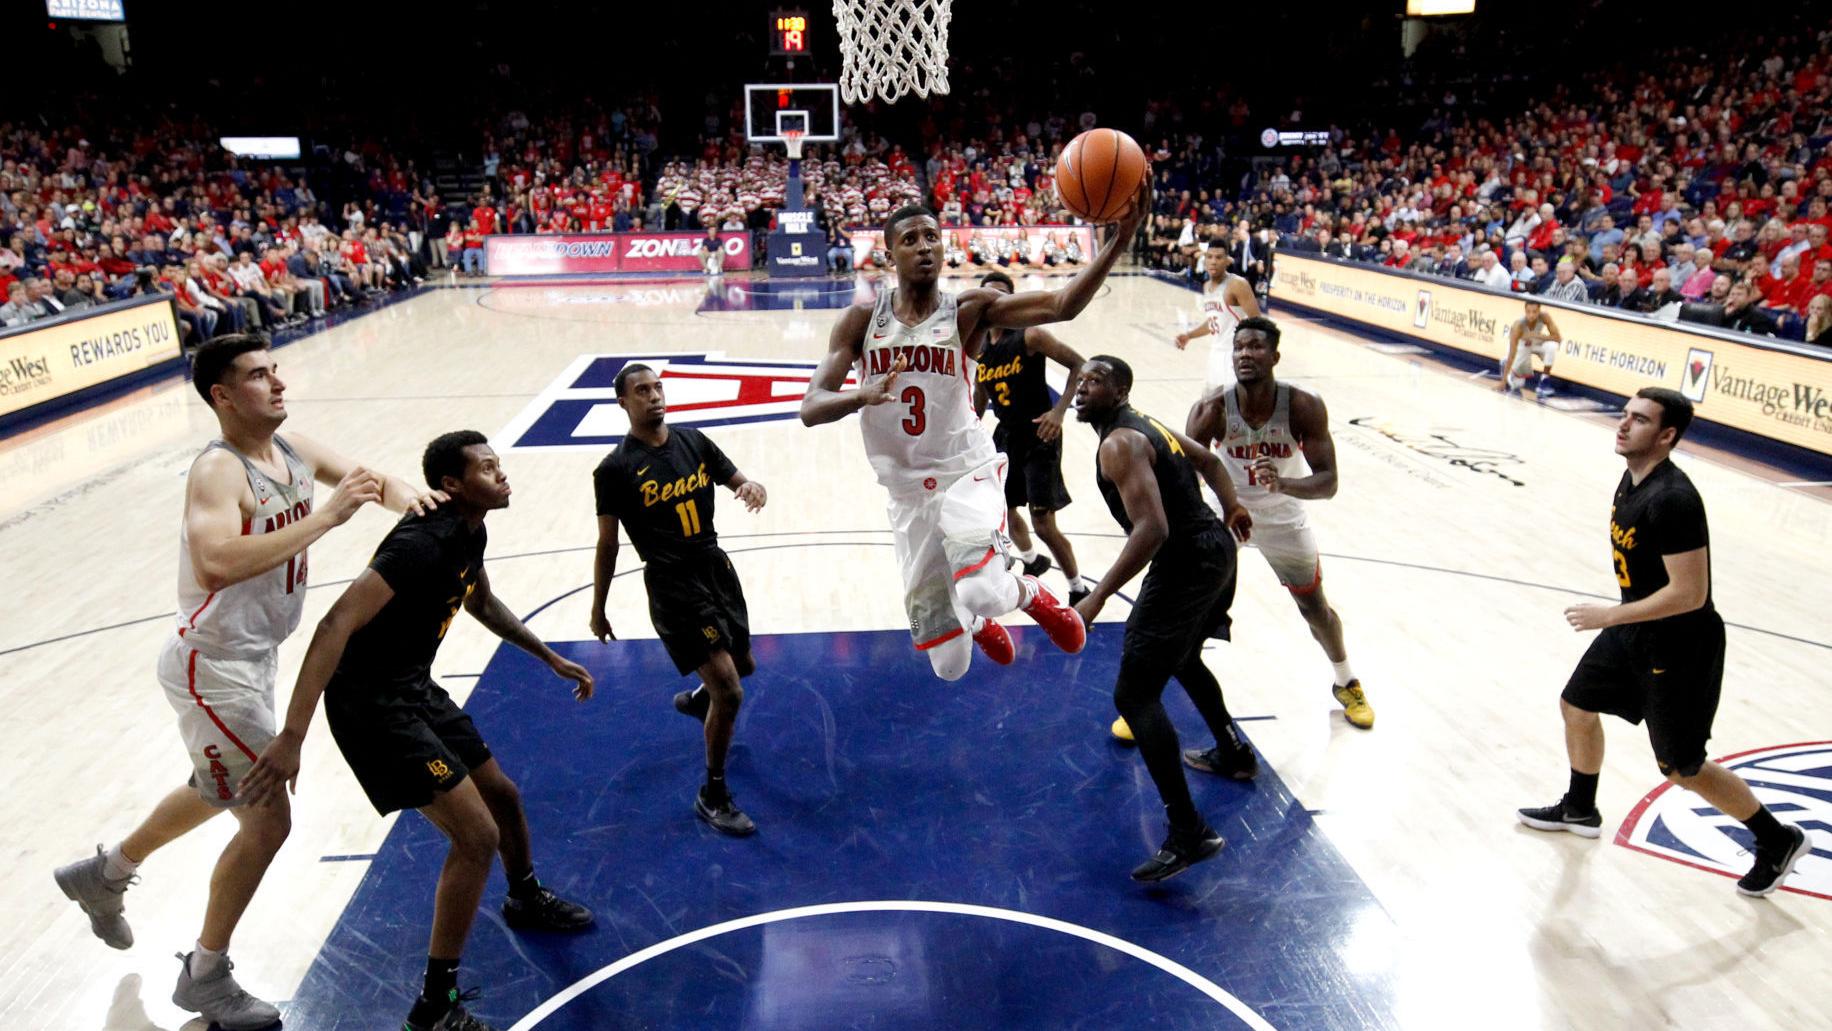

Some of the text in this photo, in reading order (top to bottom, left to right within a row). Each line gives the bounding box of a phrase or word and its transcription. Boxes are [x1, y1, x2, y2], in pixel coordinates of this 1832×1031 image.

[71, 320, 169, 368] REWARDS YOU
[870, 346, 956, 377] ARIZONA
[1566, 340, 1667, 379] ON THE HORIZON
[976, 355, 1024, 383] Beach
[901, 385, 926, 437] 3
[995, 382, 1012, 406] 2
[1226, 440, 1293, 460] ARIZONA
[639, 463, 711, 507] Beach
[675, 499, 701, 537] 11
